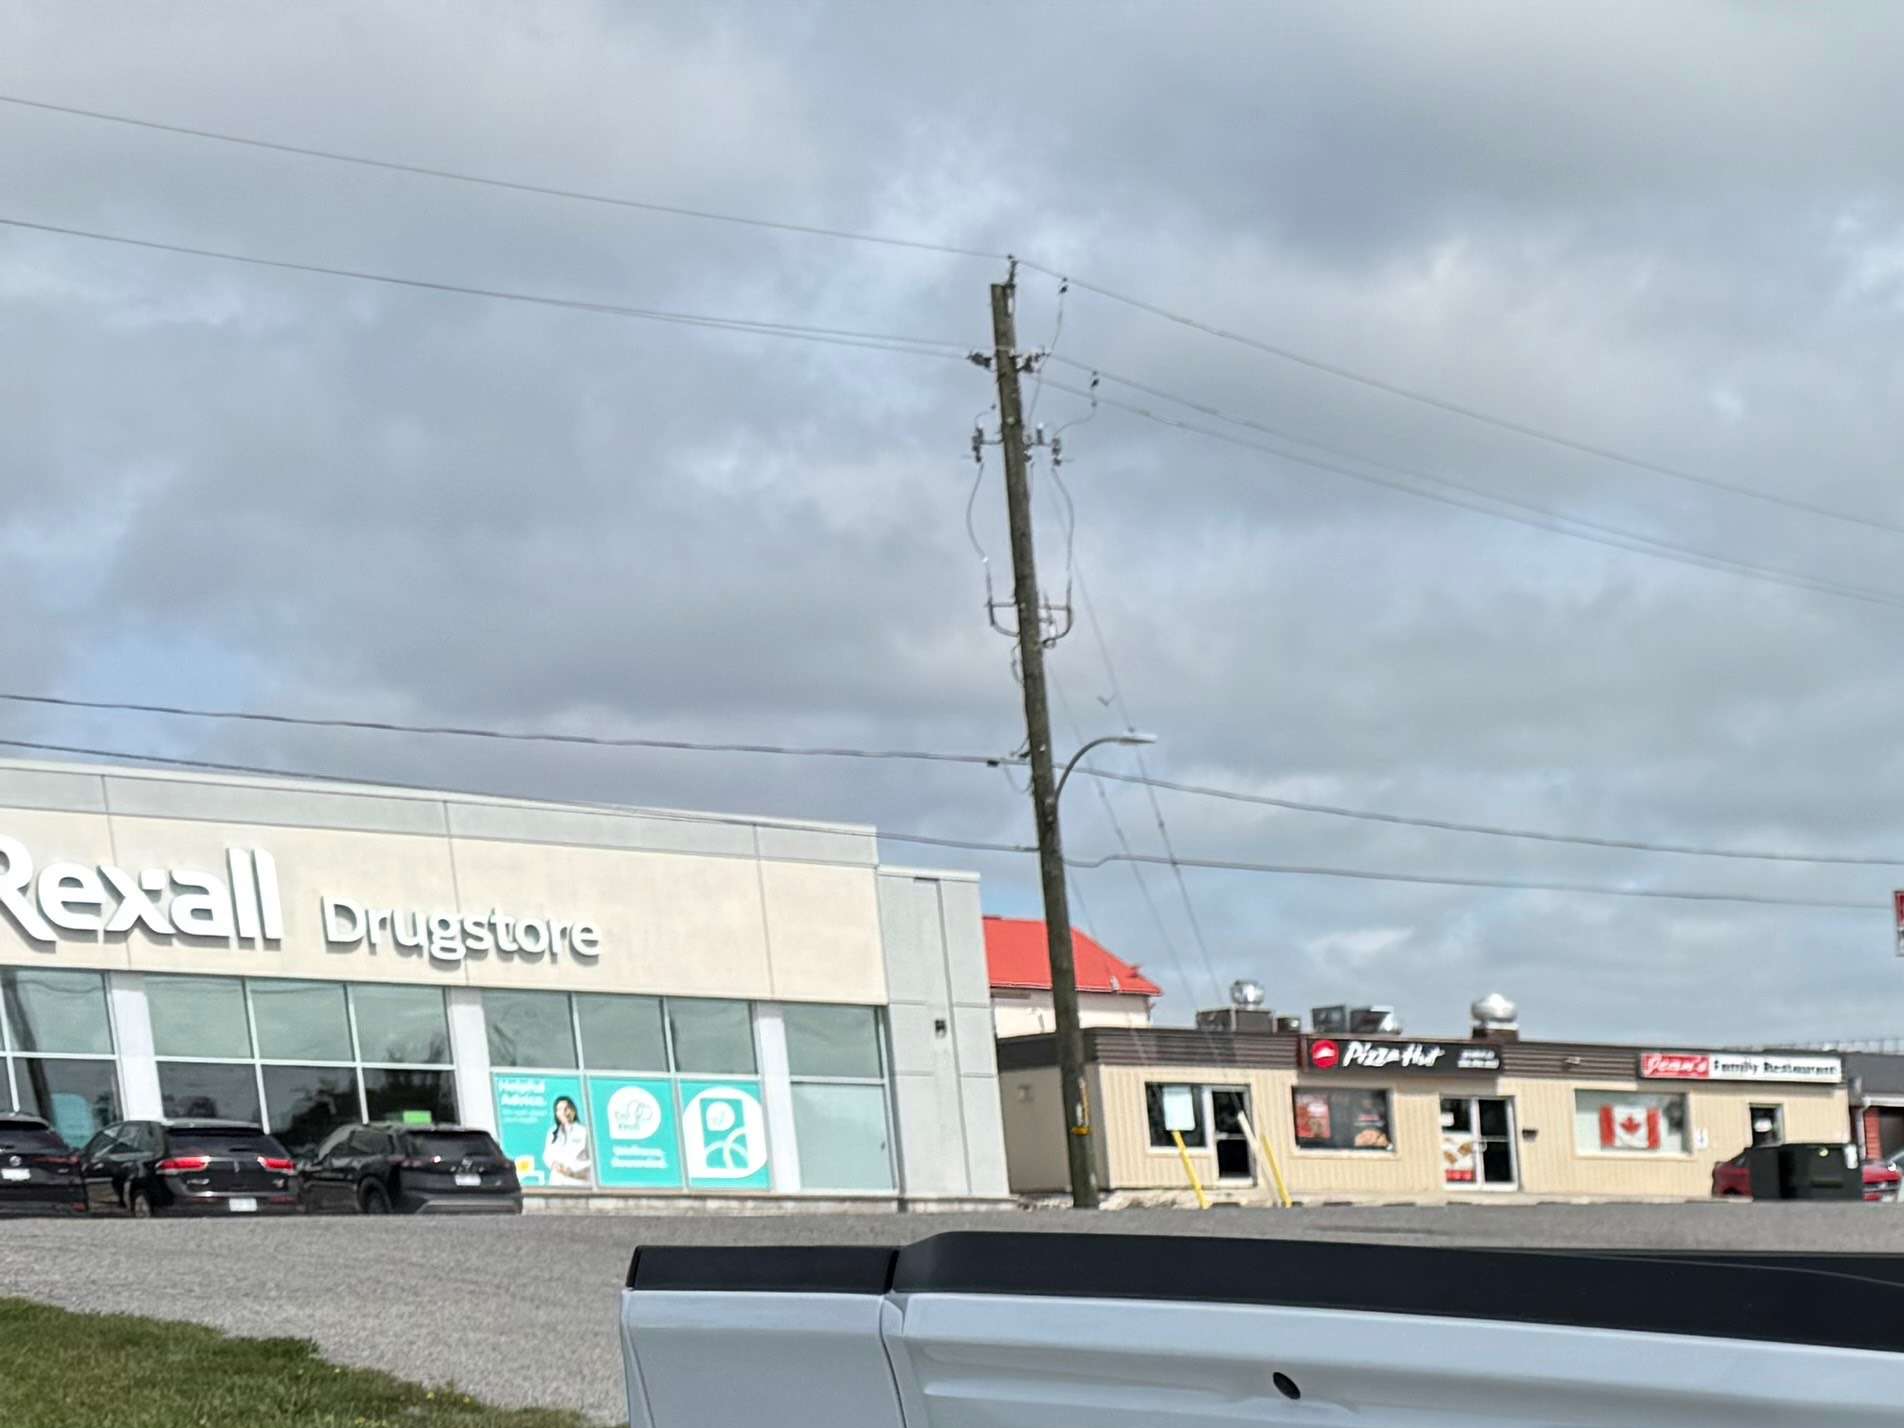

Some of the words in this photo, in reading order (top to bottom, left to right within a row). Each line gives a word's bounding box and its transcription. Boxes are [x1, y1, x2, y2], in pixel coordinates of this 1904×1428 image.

[0, 834, 282, 947] Rexall
[322, 896, 602, 962] Drugstore
[1342, 1041, 1400, 1067] Pizza
[1402, 1043, 1446, 1067] Hut
